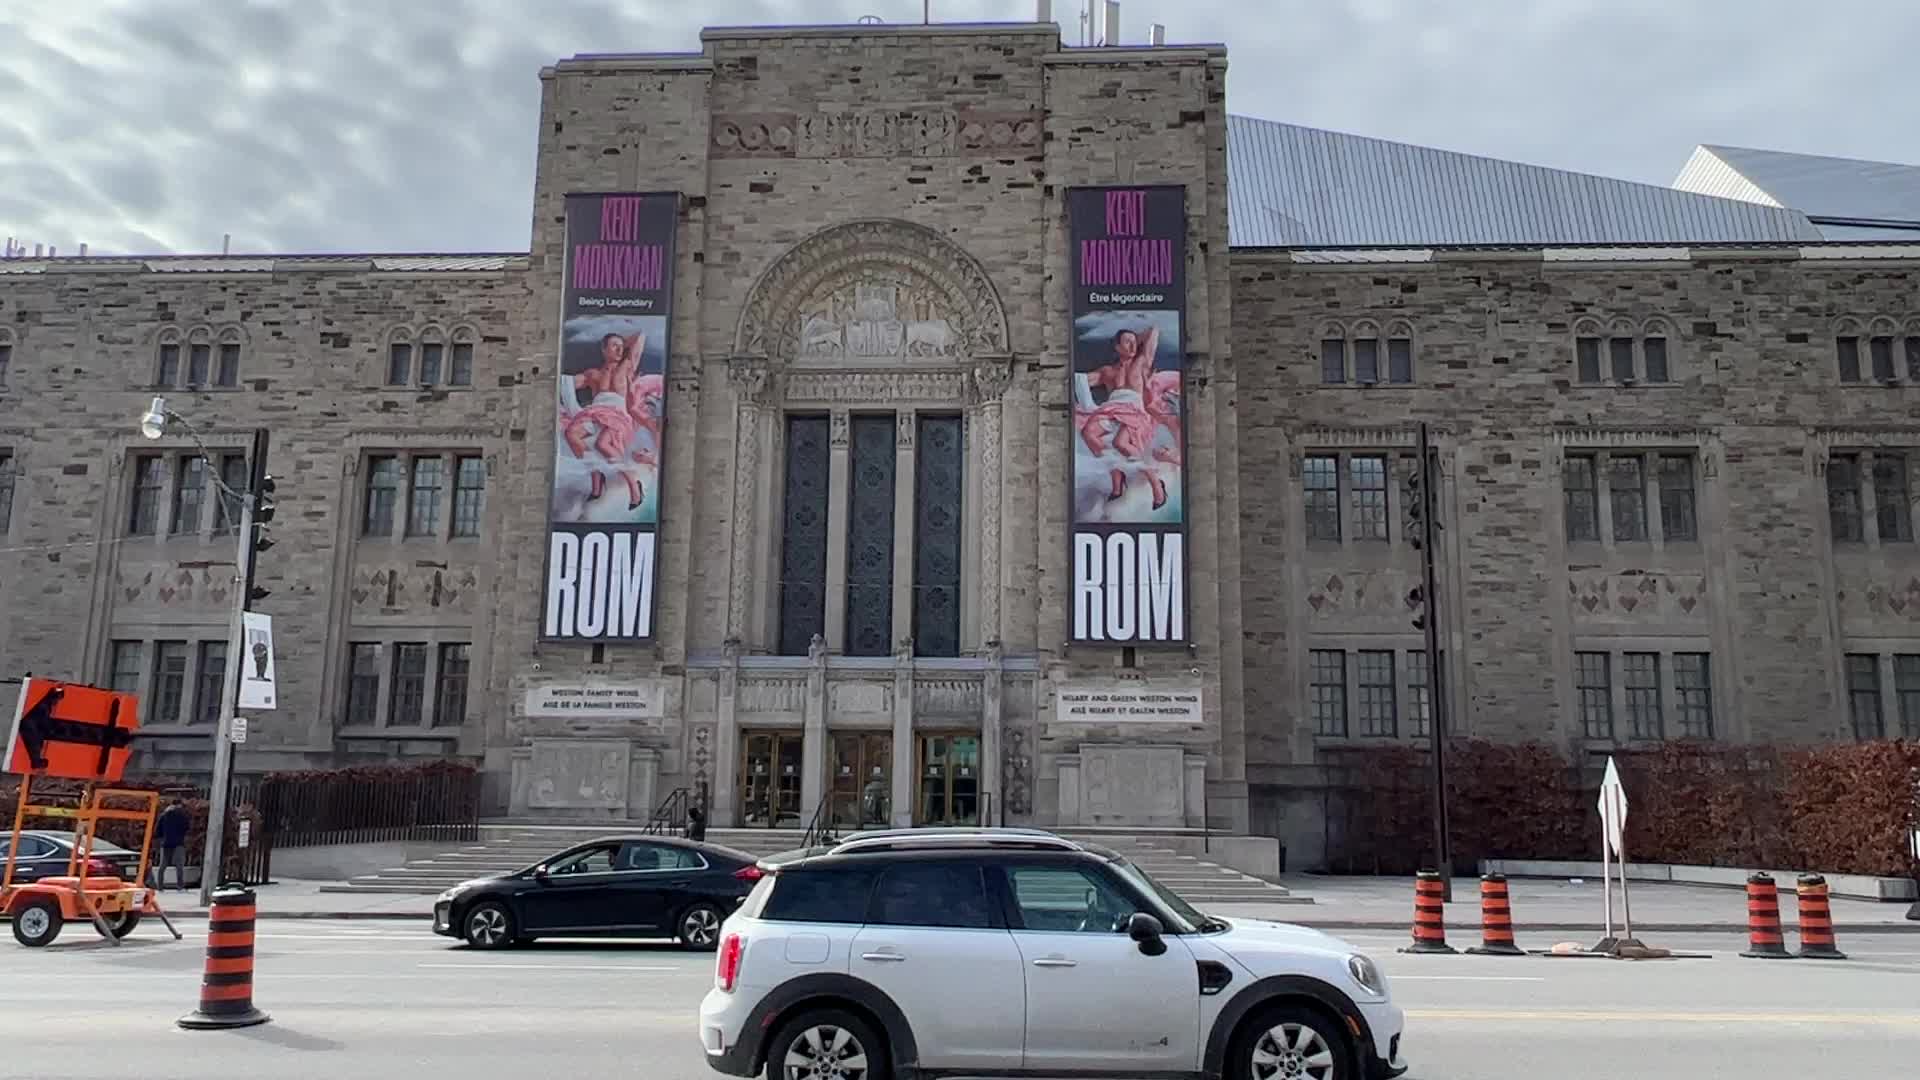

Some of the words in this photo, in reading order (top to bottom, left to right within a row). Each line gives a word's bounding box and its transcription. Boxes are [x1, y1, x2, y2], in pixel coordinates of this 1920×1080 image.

[600, 196, 643, 241] KENT
[1105, 191, 1146, 236] KENT
[573, 244, 664, 290] MONKMAN
[1081, 239, 1172, 286] MONKMAN
[578, 296, 605, 308] Being
[606, 297, 654, 309] Legendary
[1111, 292, 1164, 304] légendaire
[545, 531, 655, 637] ROM
[1074, 531, 1183, 640] ROM
[551, 689, 583, 697] WESTON
